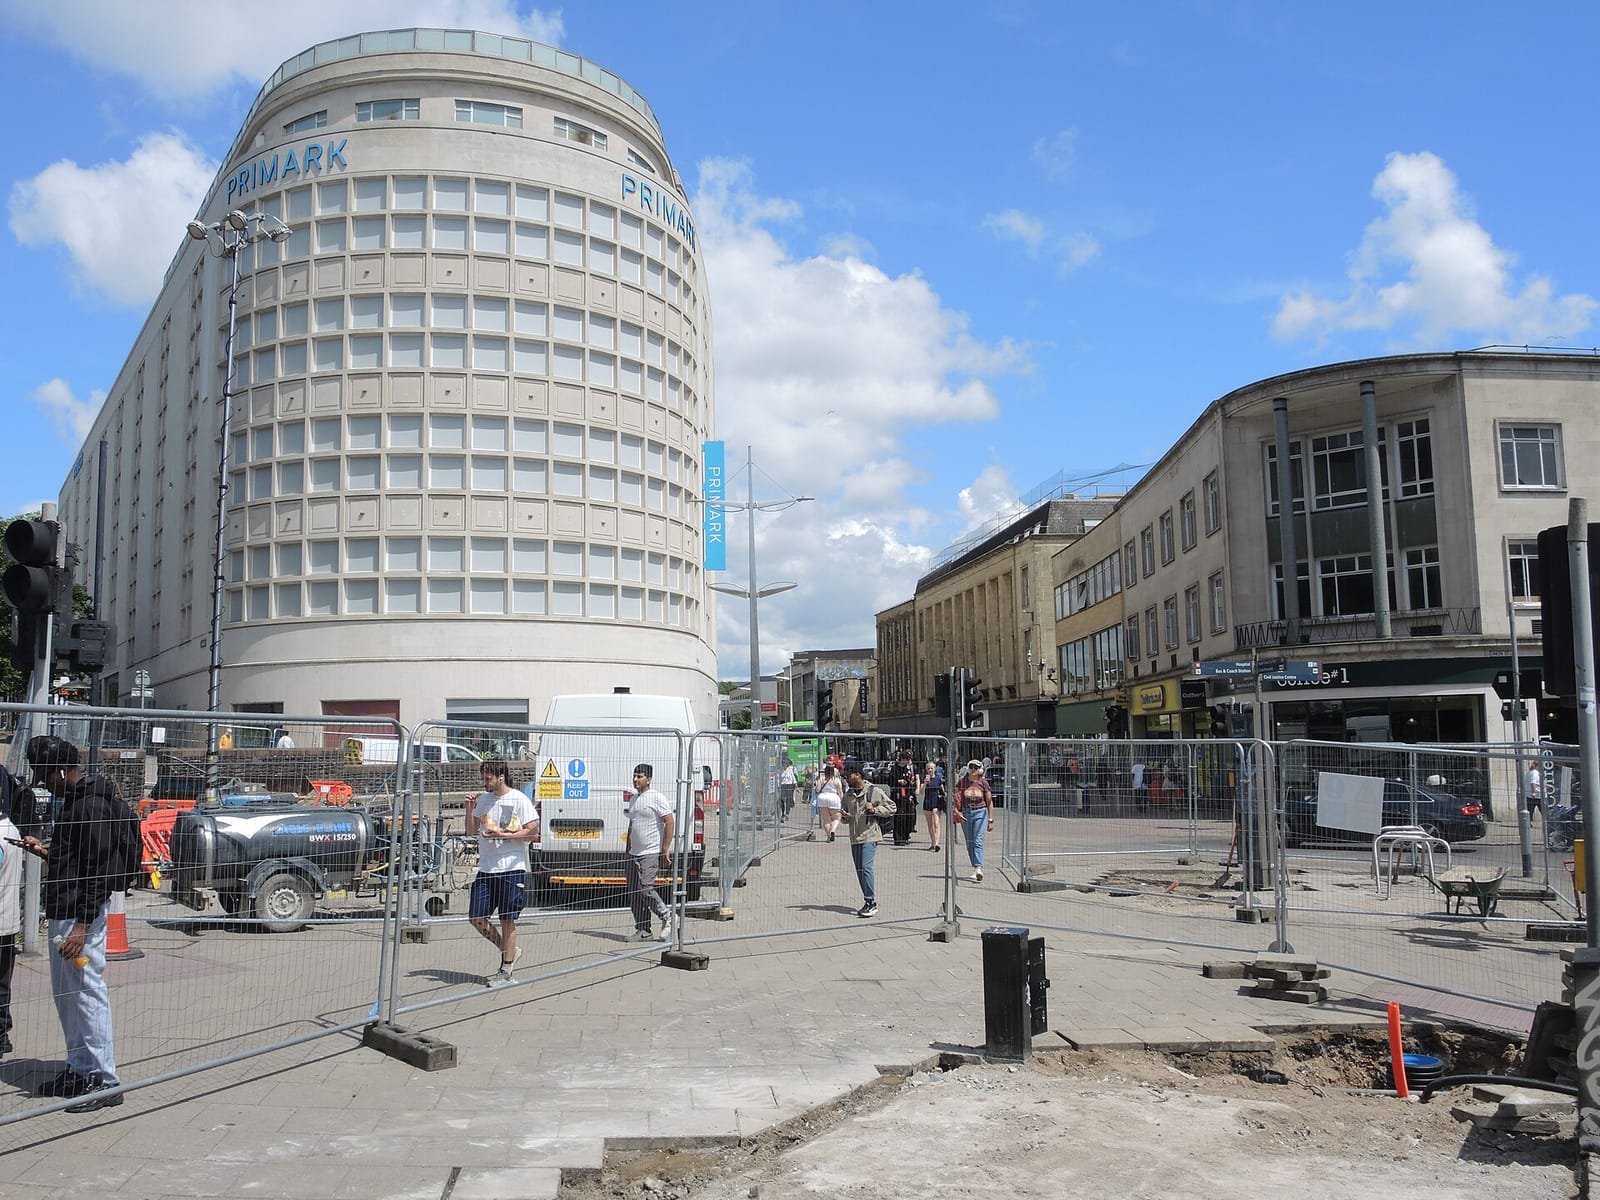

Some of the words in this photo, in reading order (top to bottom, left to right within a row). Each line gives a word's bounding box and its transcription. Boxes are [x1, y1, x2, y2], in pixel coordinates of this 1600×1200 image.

[226, 139, 348, 205] PRIMARK
[622, 173, 696, 254] PRIMARK
[309, 834, 331, 842] BWX
[333, 833, 357, 841] 15/250
